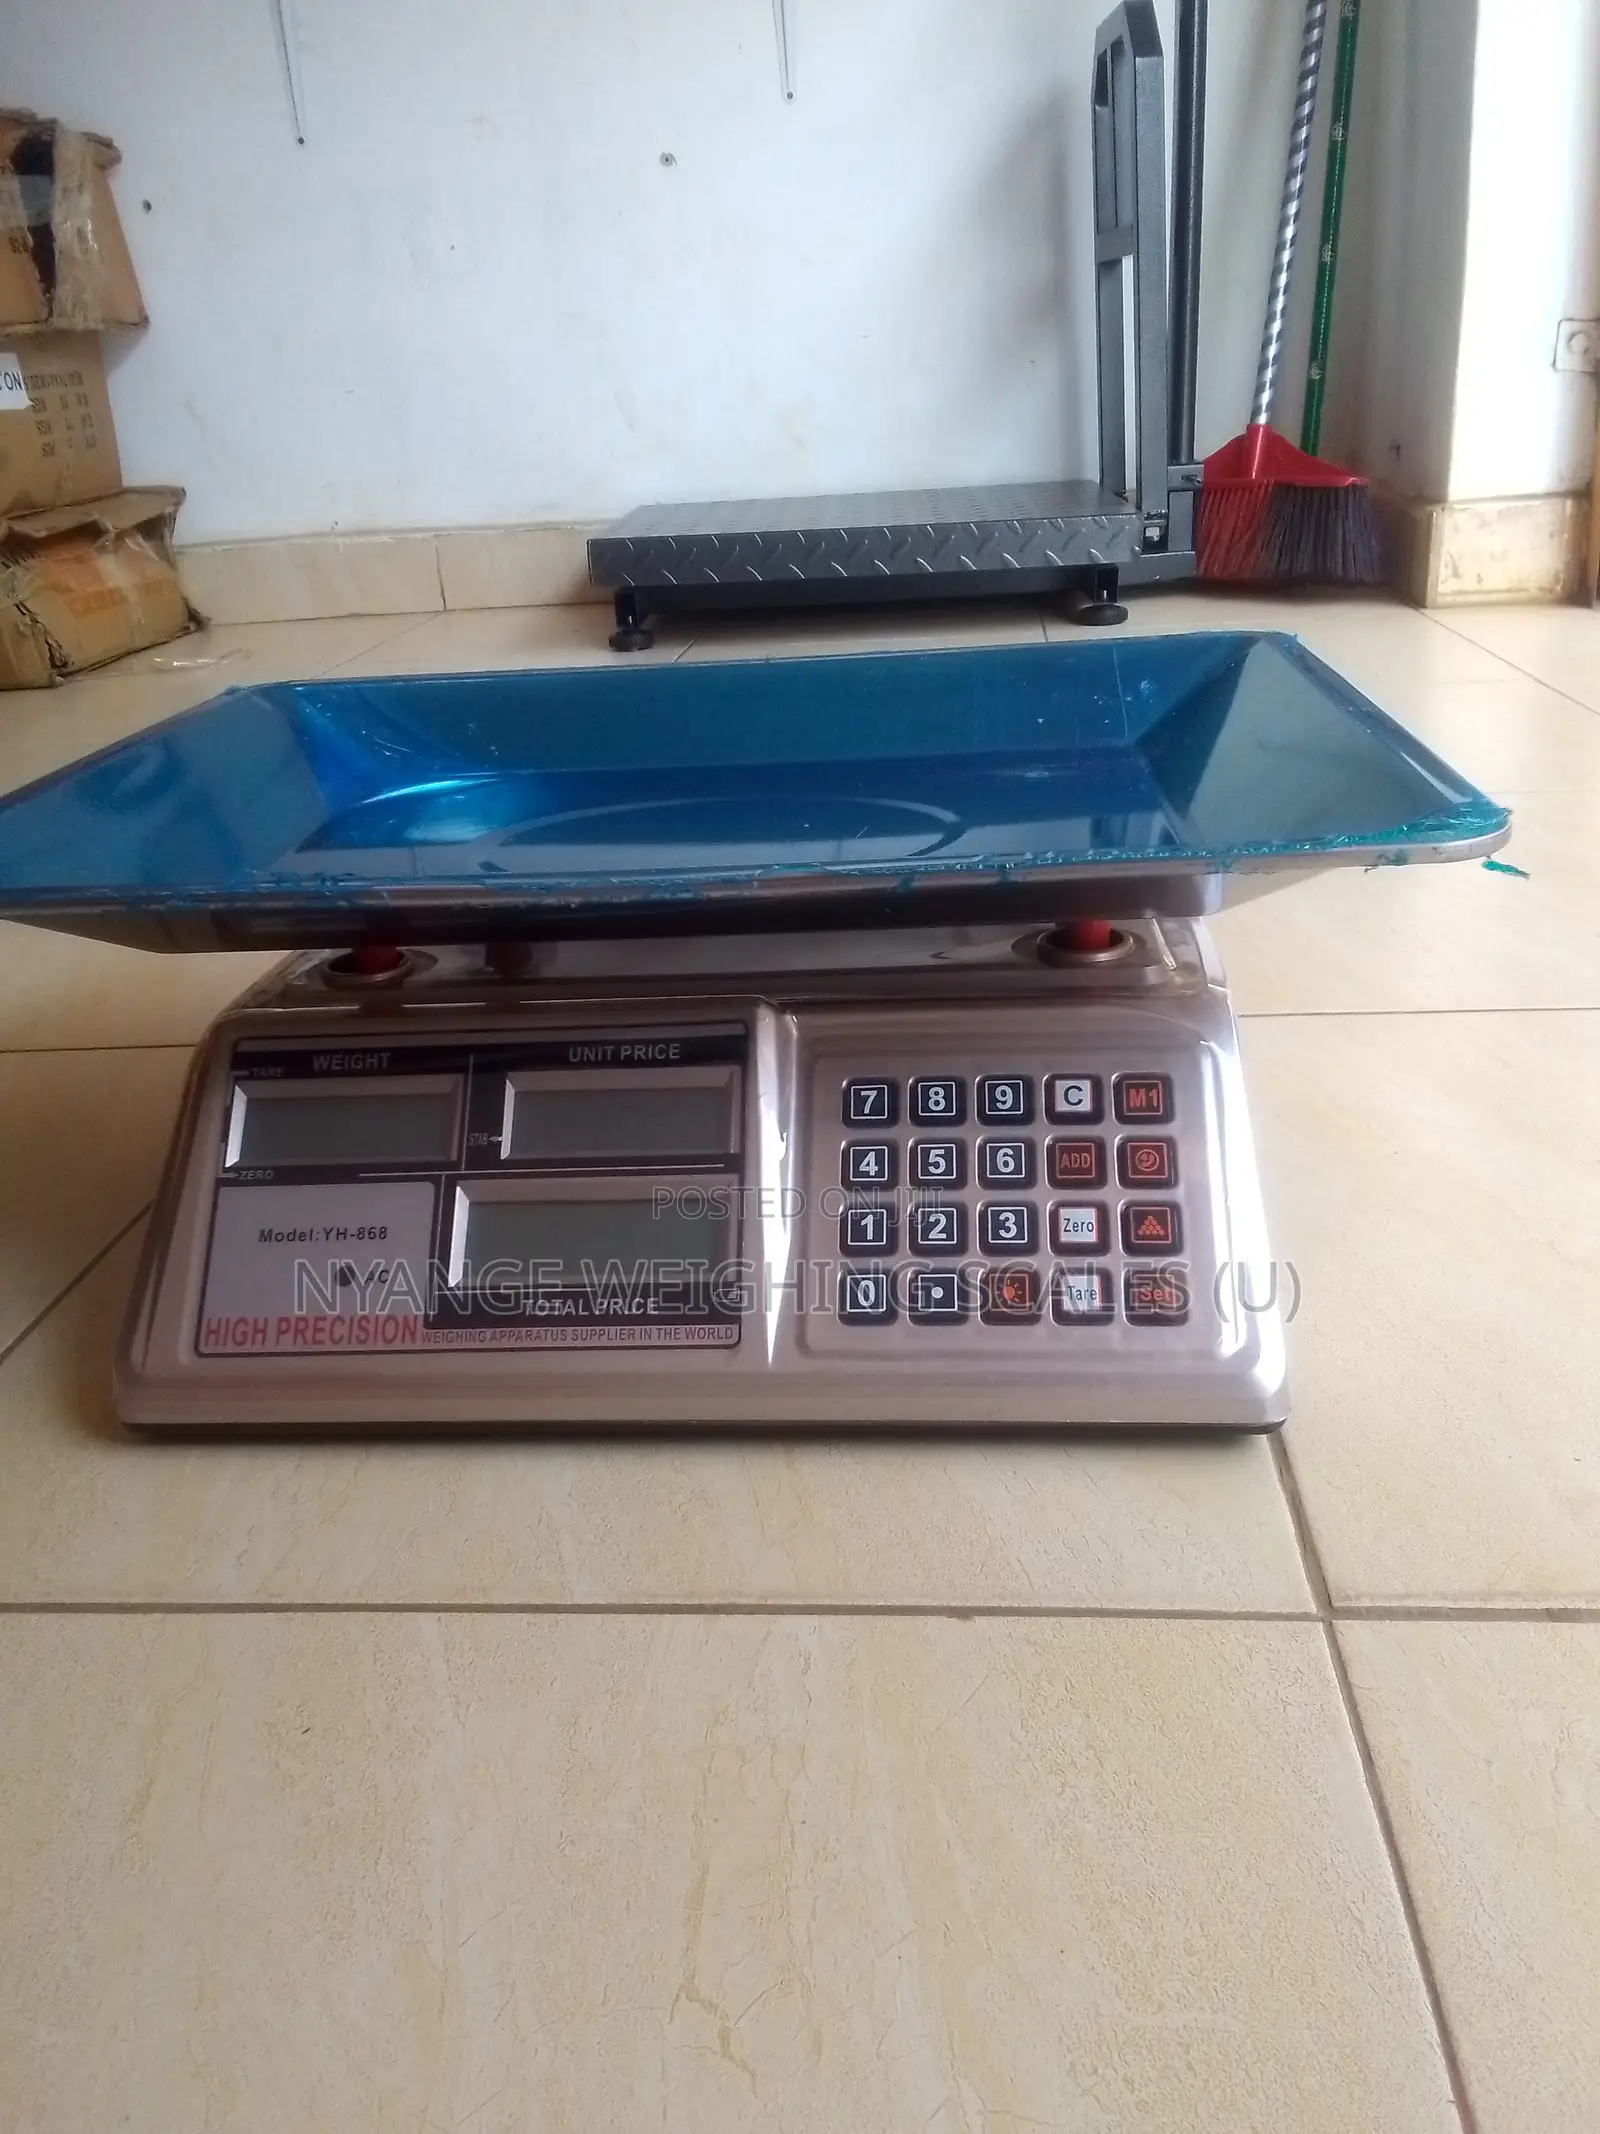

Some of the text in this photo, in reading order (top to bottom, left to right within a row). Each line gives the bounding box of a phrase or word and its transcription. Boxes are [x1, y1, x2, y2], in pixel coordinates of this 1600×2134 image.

[312, 1052, 391, 1071] WEIGHT
[569, 1043, 681, 1062] UNIT PRICE
[251, 1067, 284, 1078] TARE
[860, 1089, 878, 1115] 7
[928, 1085, 946, 1111] 8
[994, 1084, 1013, 1110] 9
[1062, 1084, 1084, 1107] C
[1128, 1087, 1160, 1109] M1
[859, 1150, 879, 1176] 4
[928, 1148, 946, 1174] 5
[996, 1147, 1014, 1173] 6
[1060, 1151, 1091, 1169] ADD
[238, 1169, 274, 1181] ZERO
[860, 1214, 874, 1240] 1
[928, 1213, 948, 1240] 2
[999, 1211, 1018, 1238] 3
[1063, 1217, 1095, 1234] Zero
[364, 1269, 389, 1284] AC
[857, 1279, 876, 1307] 0
[1067, 1285, 1098, 1301] Tare
[523, 1297, 659, 1317] TOTAL PRICE
[203, 1314, 418, 1348] HIGH PRECISION
[421, 1325, 734, 1344] WEIGHING APPARATUS SUPPLIER IN THE WORLD
